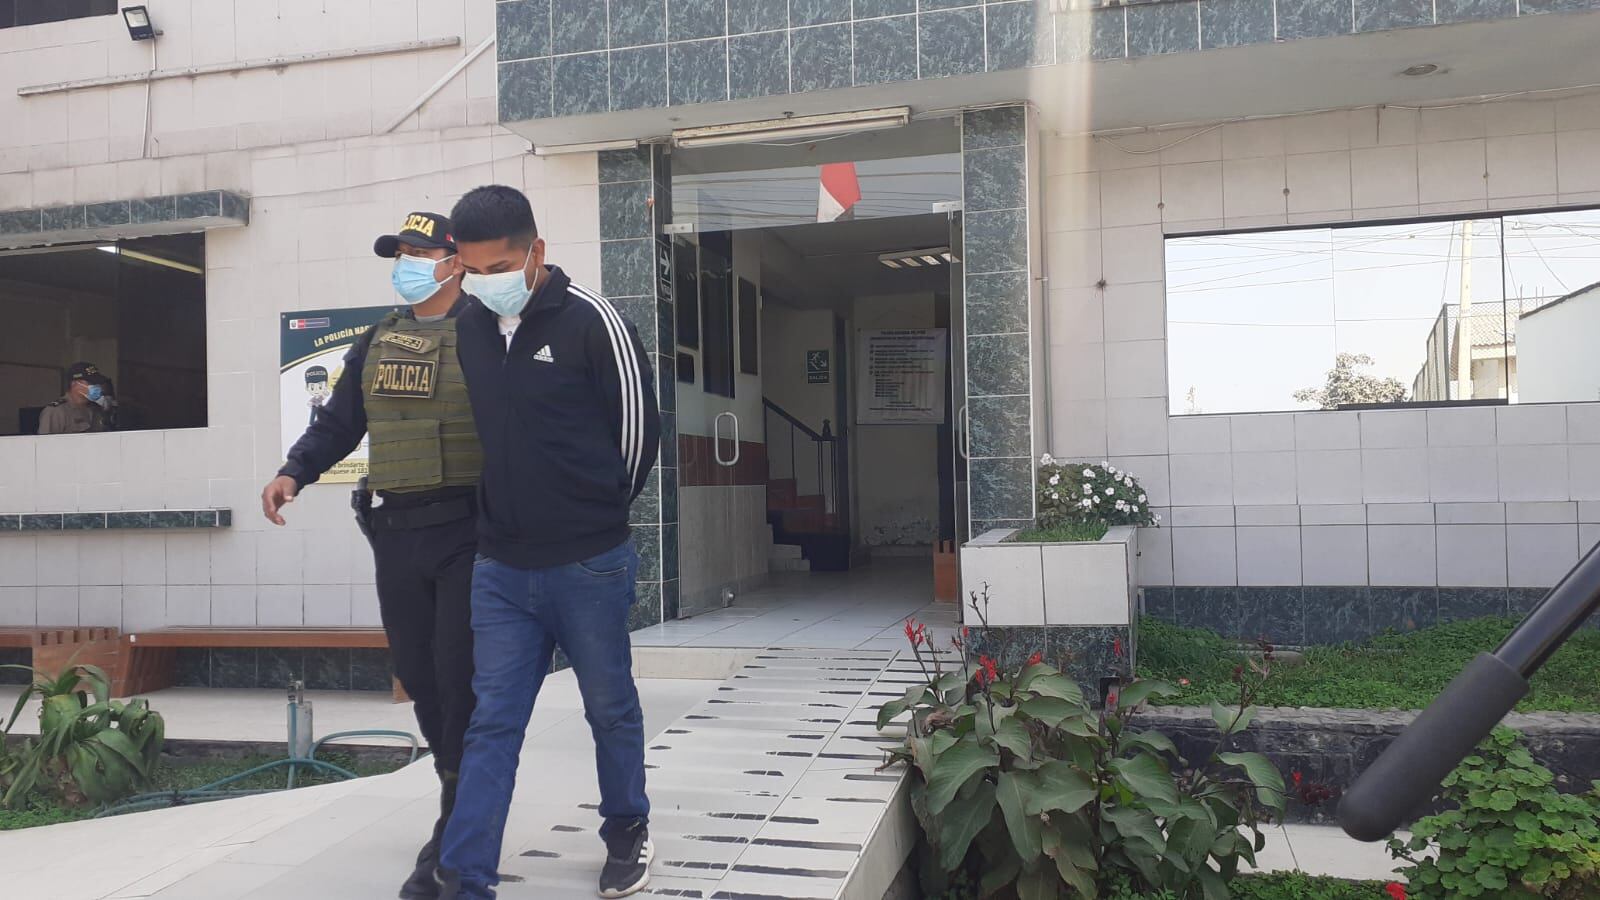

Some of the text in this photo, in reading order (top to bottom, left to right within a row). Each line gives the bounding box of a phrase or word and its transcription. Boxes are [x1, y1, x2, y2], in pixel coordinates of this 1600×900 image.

[314, 338, 324, 347] LA
[324, 328, 354, 343] POLICÍA
[533, 354, 554, 362] adidas
[375, 364, 430, 391] POLICIA
